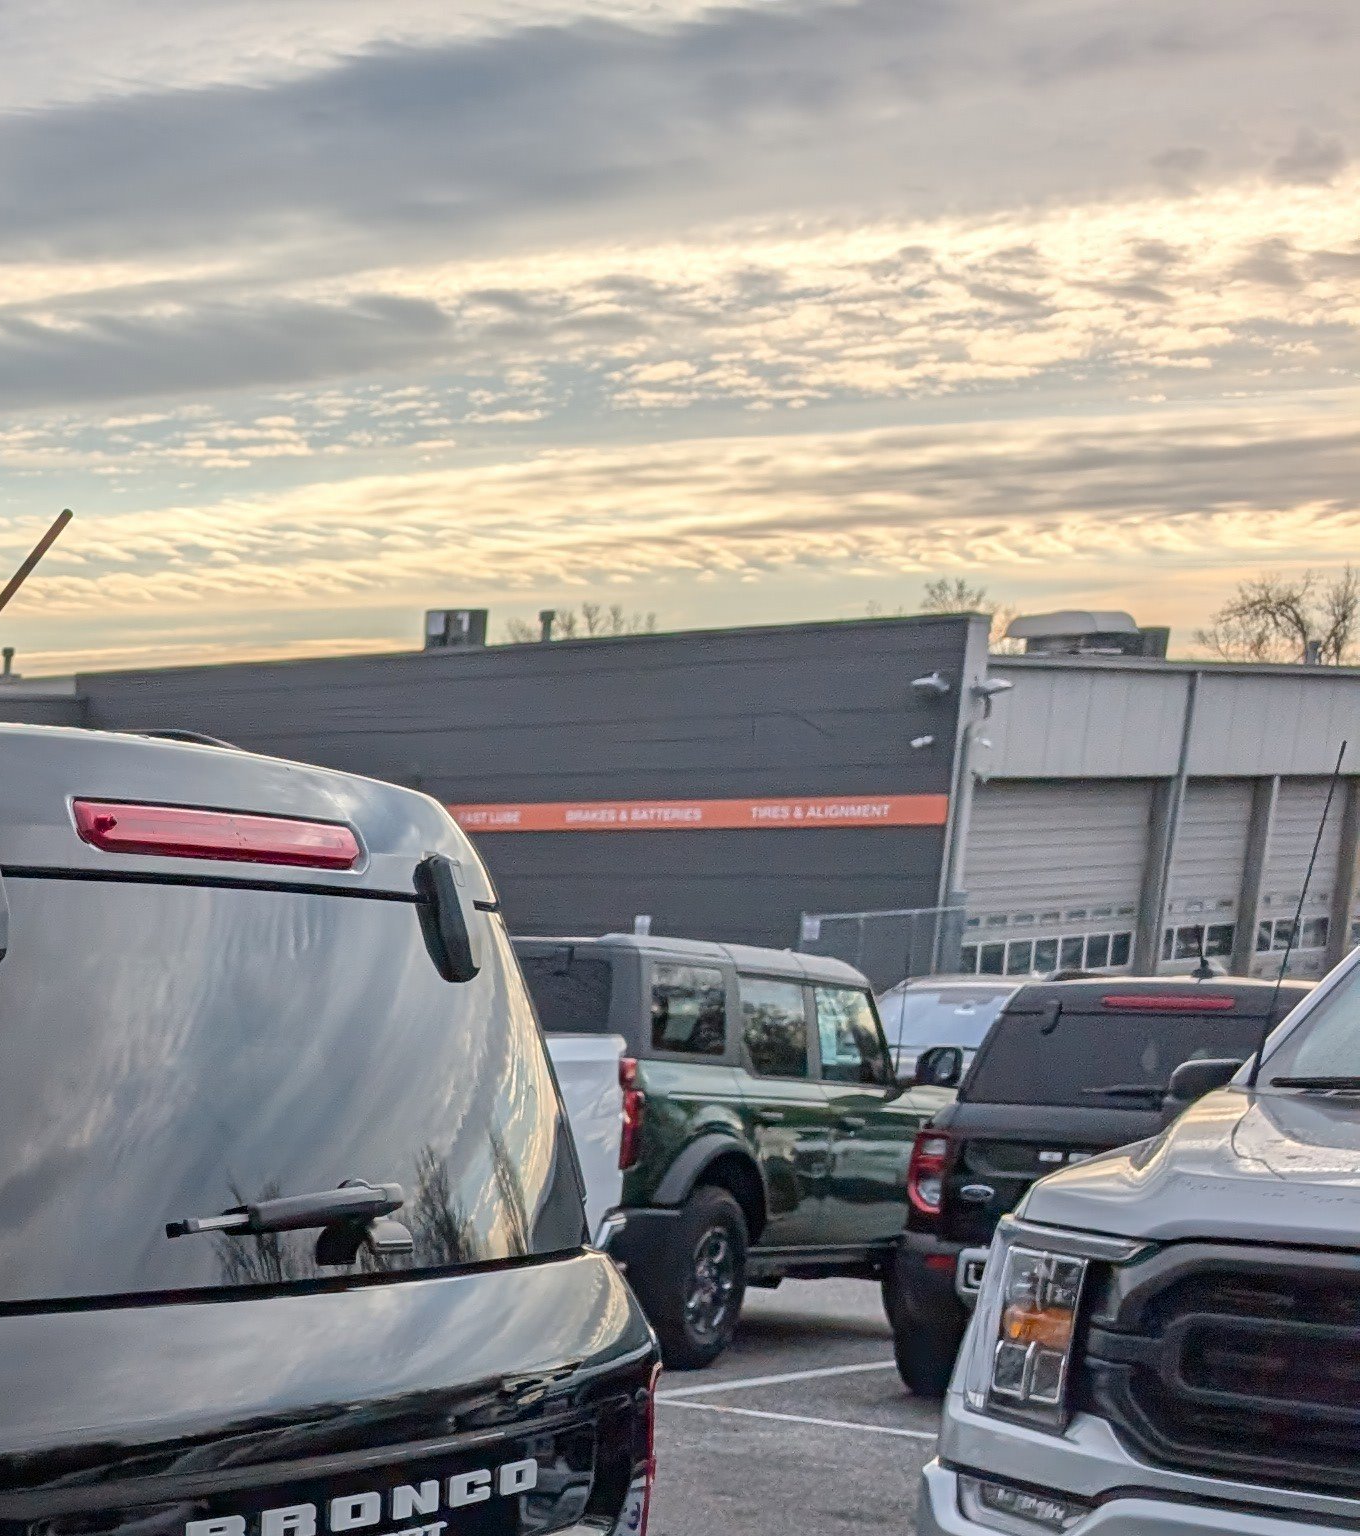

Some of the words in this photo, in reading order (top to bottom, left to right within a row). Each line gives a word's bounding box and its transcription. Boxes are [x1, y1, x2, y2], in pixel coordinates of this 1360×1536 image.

[565, 809, 615, 822] BRAKES
[631, 808, 702, 821] BATTERIES
[752, 806, 789, 819] TIRES
[793, 806, 804, 819] &
[806, 804, 891, 818] ALIGNMENT
